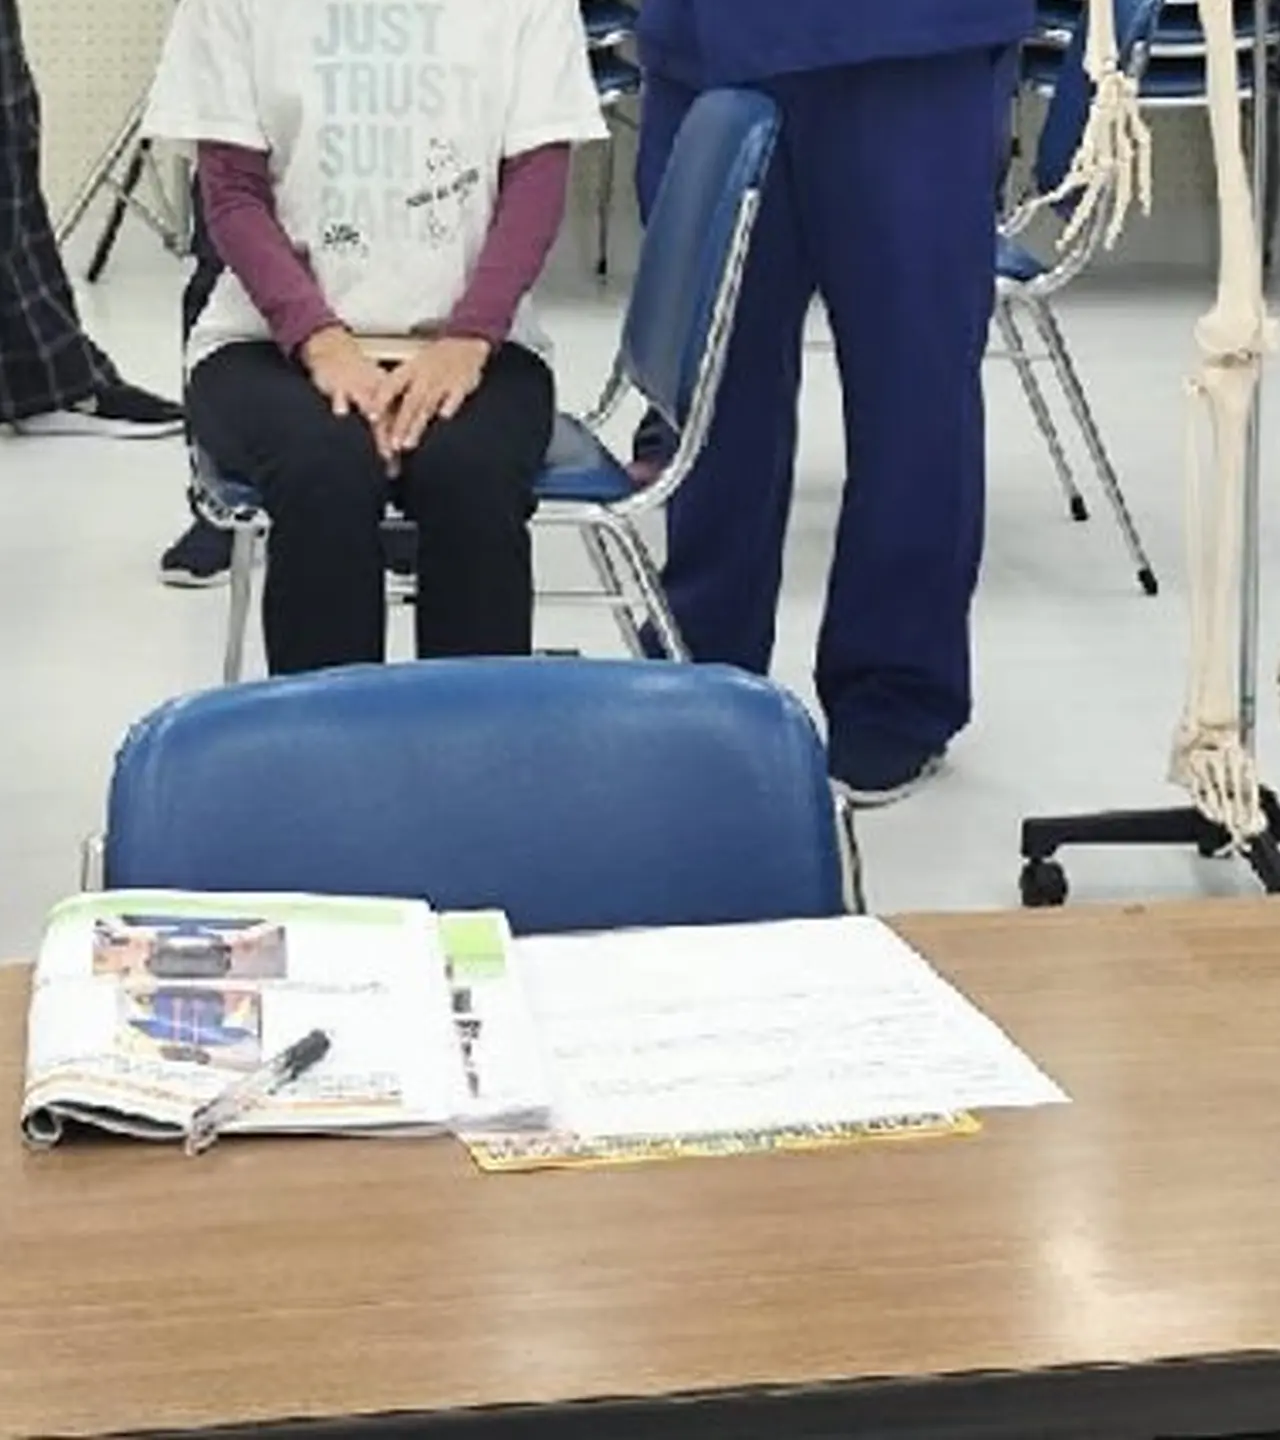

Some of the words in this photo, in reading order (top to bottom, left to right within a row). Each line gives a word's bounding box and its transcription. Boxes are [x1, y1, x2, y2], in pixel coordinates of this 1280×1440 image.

[313, 2, 445, 56] JUST
[313, 62, 478, 118] TRUST
[317, 123, 413, 179] SUN
